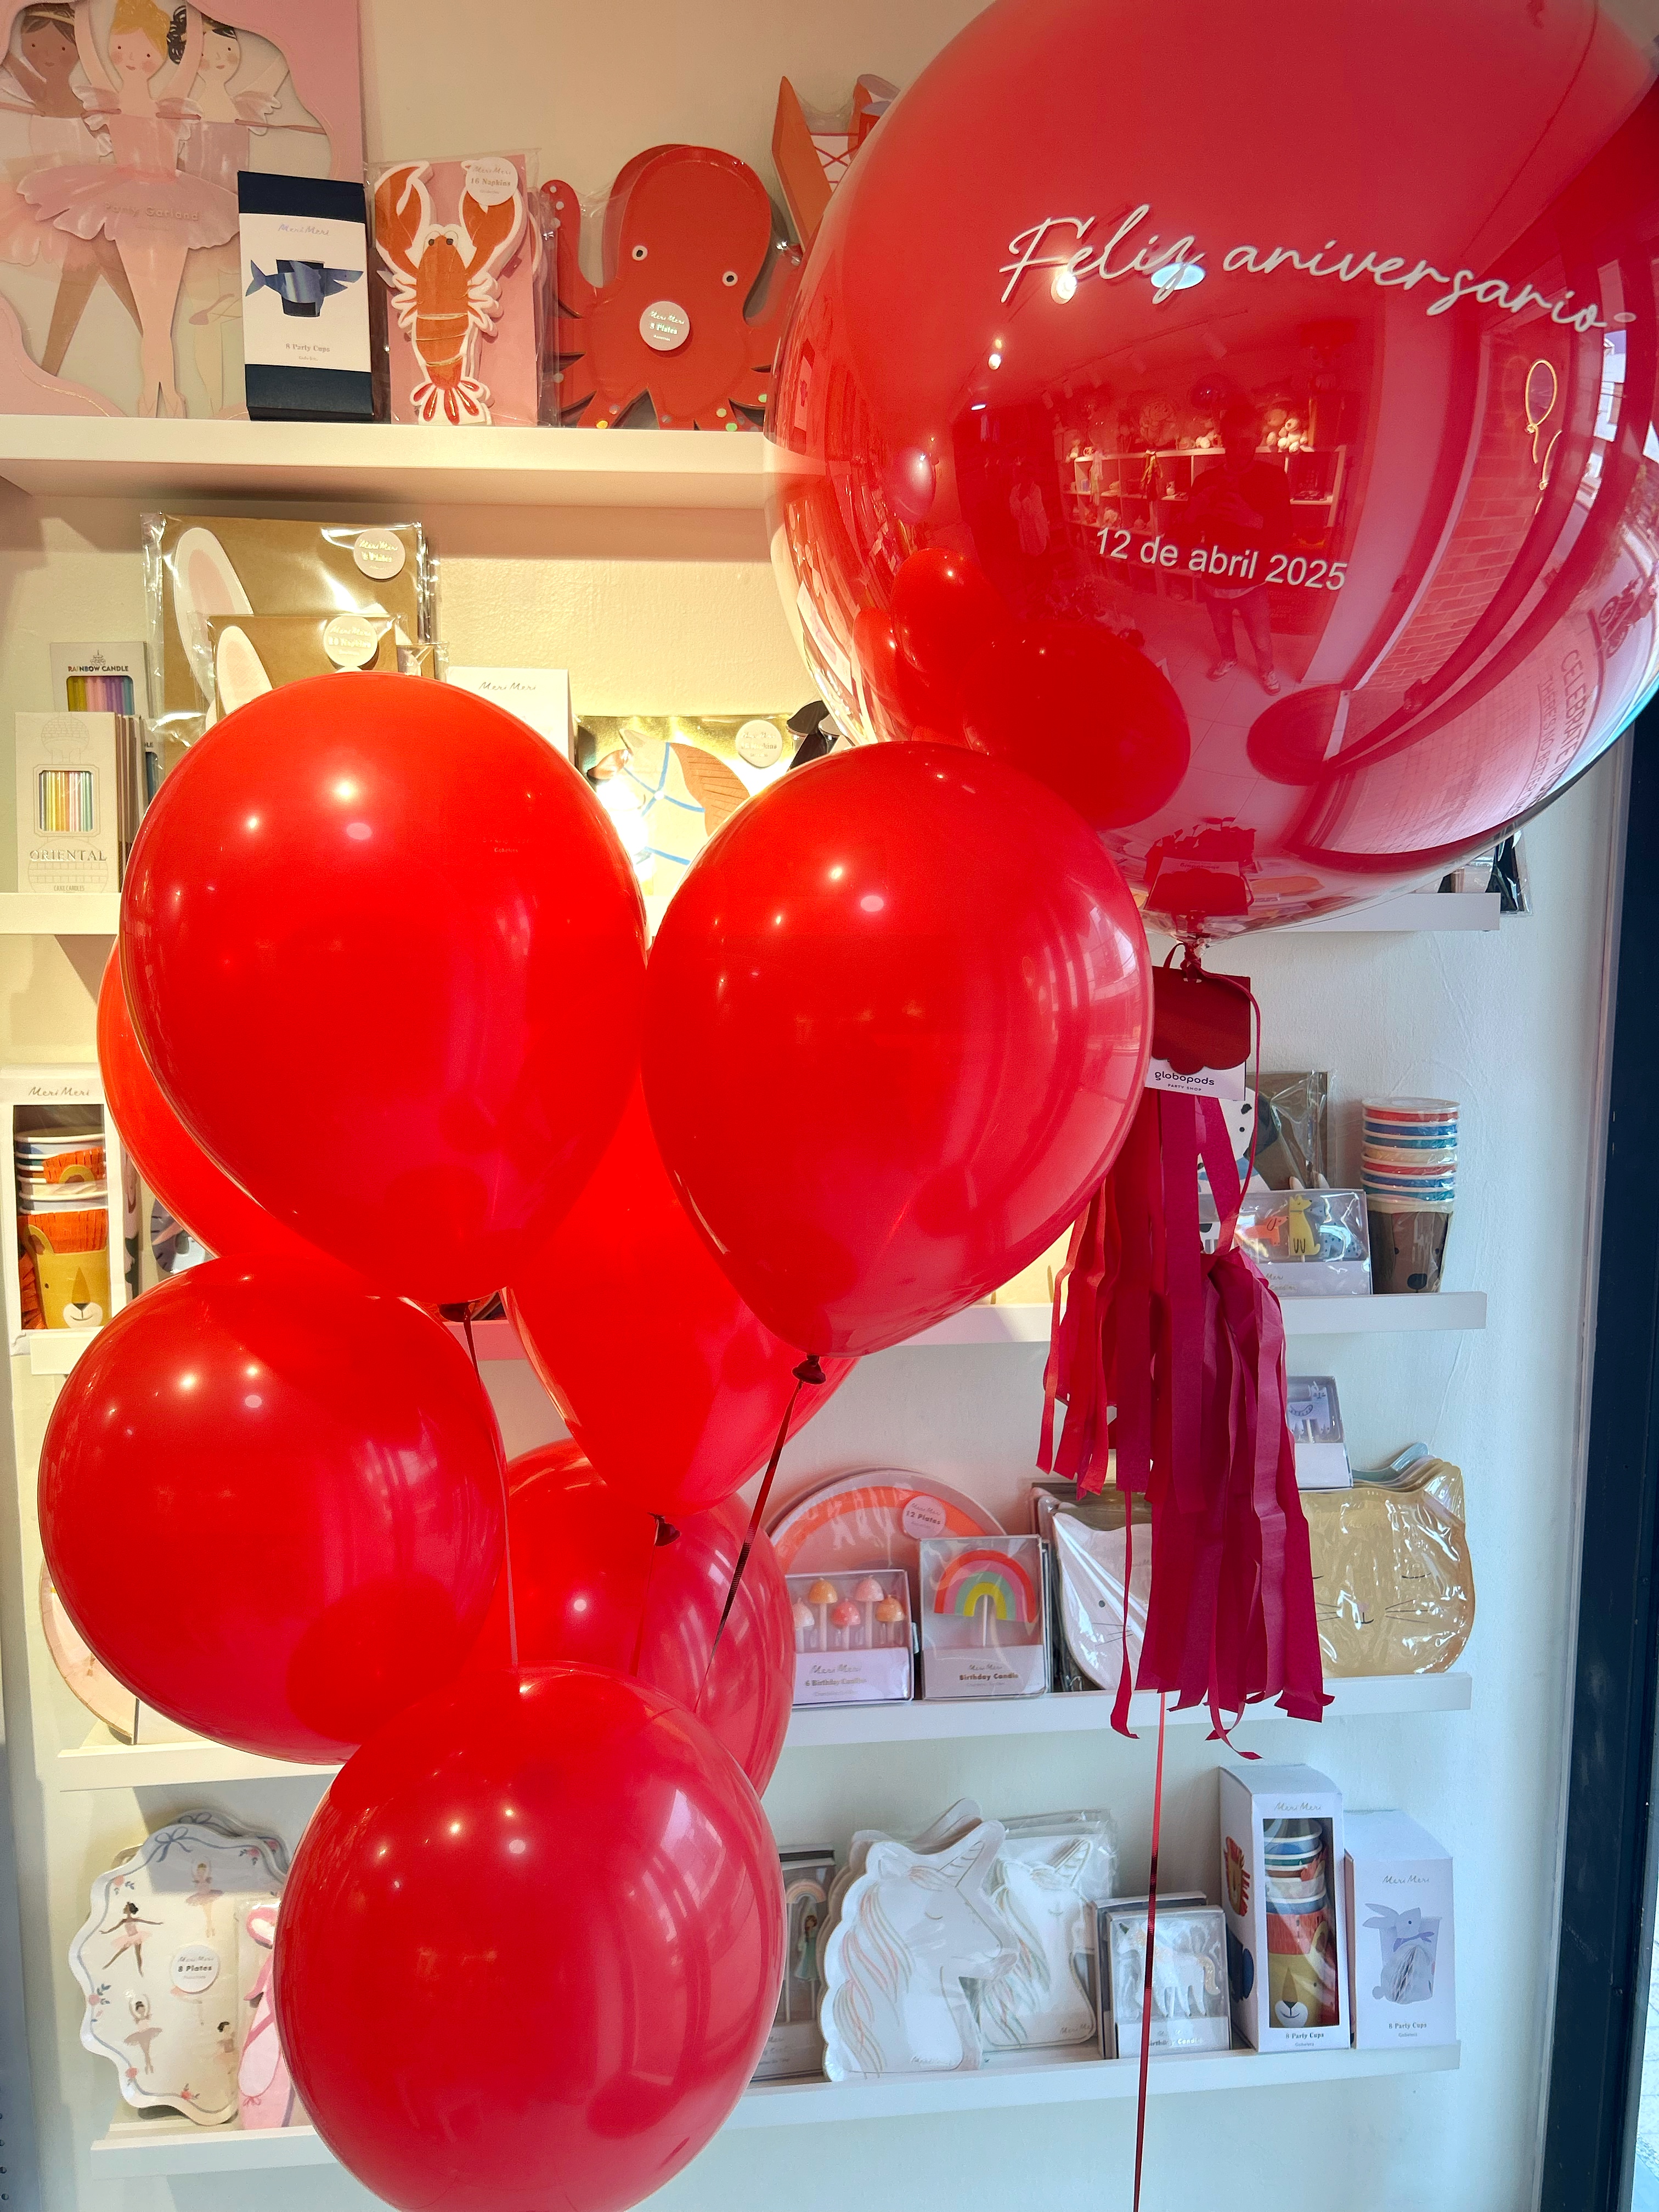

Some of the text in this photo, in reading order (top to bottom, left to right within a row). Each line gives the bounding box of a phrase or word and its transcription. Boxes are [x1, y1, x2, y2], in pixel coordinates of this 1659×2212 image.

[482, 178, 511, 187] Napkins
[145, 206, 199, 221] Garland
[999, 204, 1608, 332] Feliz aniversario
[656, 323, 678, 335] Plates
[292, 343, 311, 352] Party
[1097, 527, 1348, 591] 12 de abril 2025
[478, 681, 537, 691] Meri Meri
[1555, 649, 1589, 764] CELEBRATE
[30, 850, 108, 862] ORIENTAL
[1154, 1071, 1215, 1086] globopods
[28, 1086, 90, 1096] Meri Meri
[917, 1514, 941, 1525] Plates
